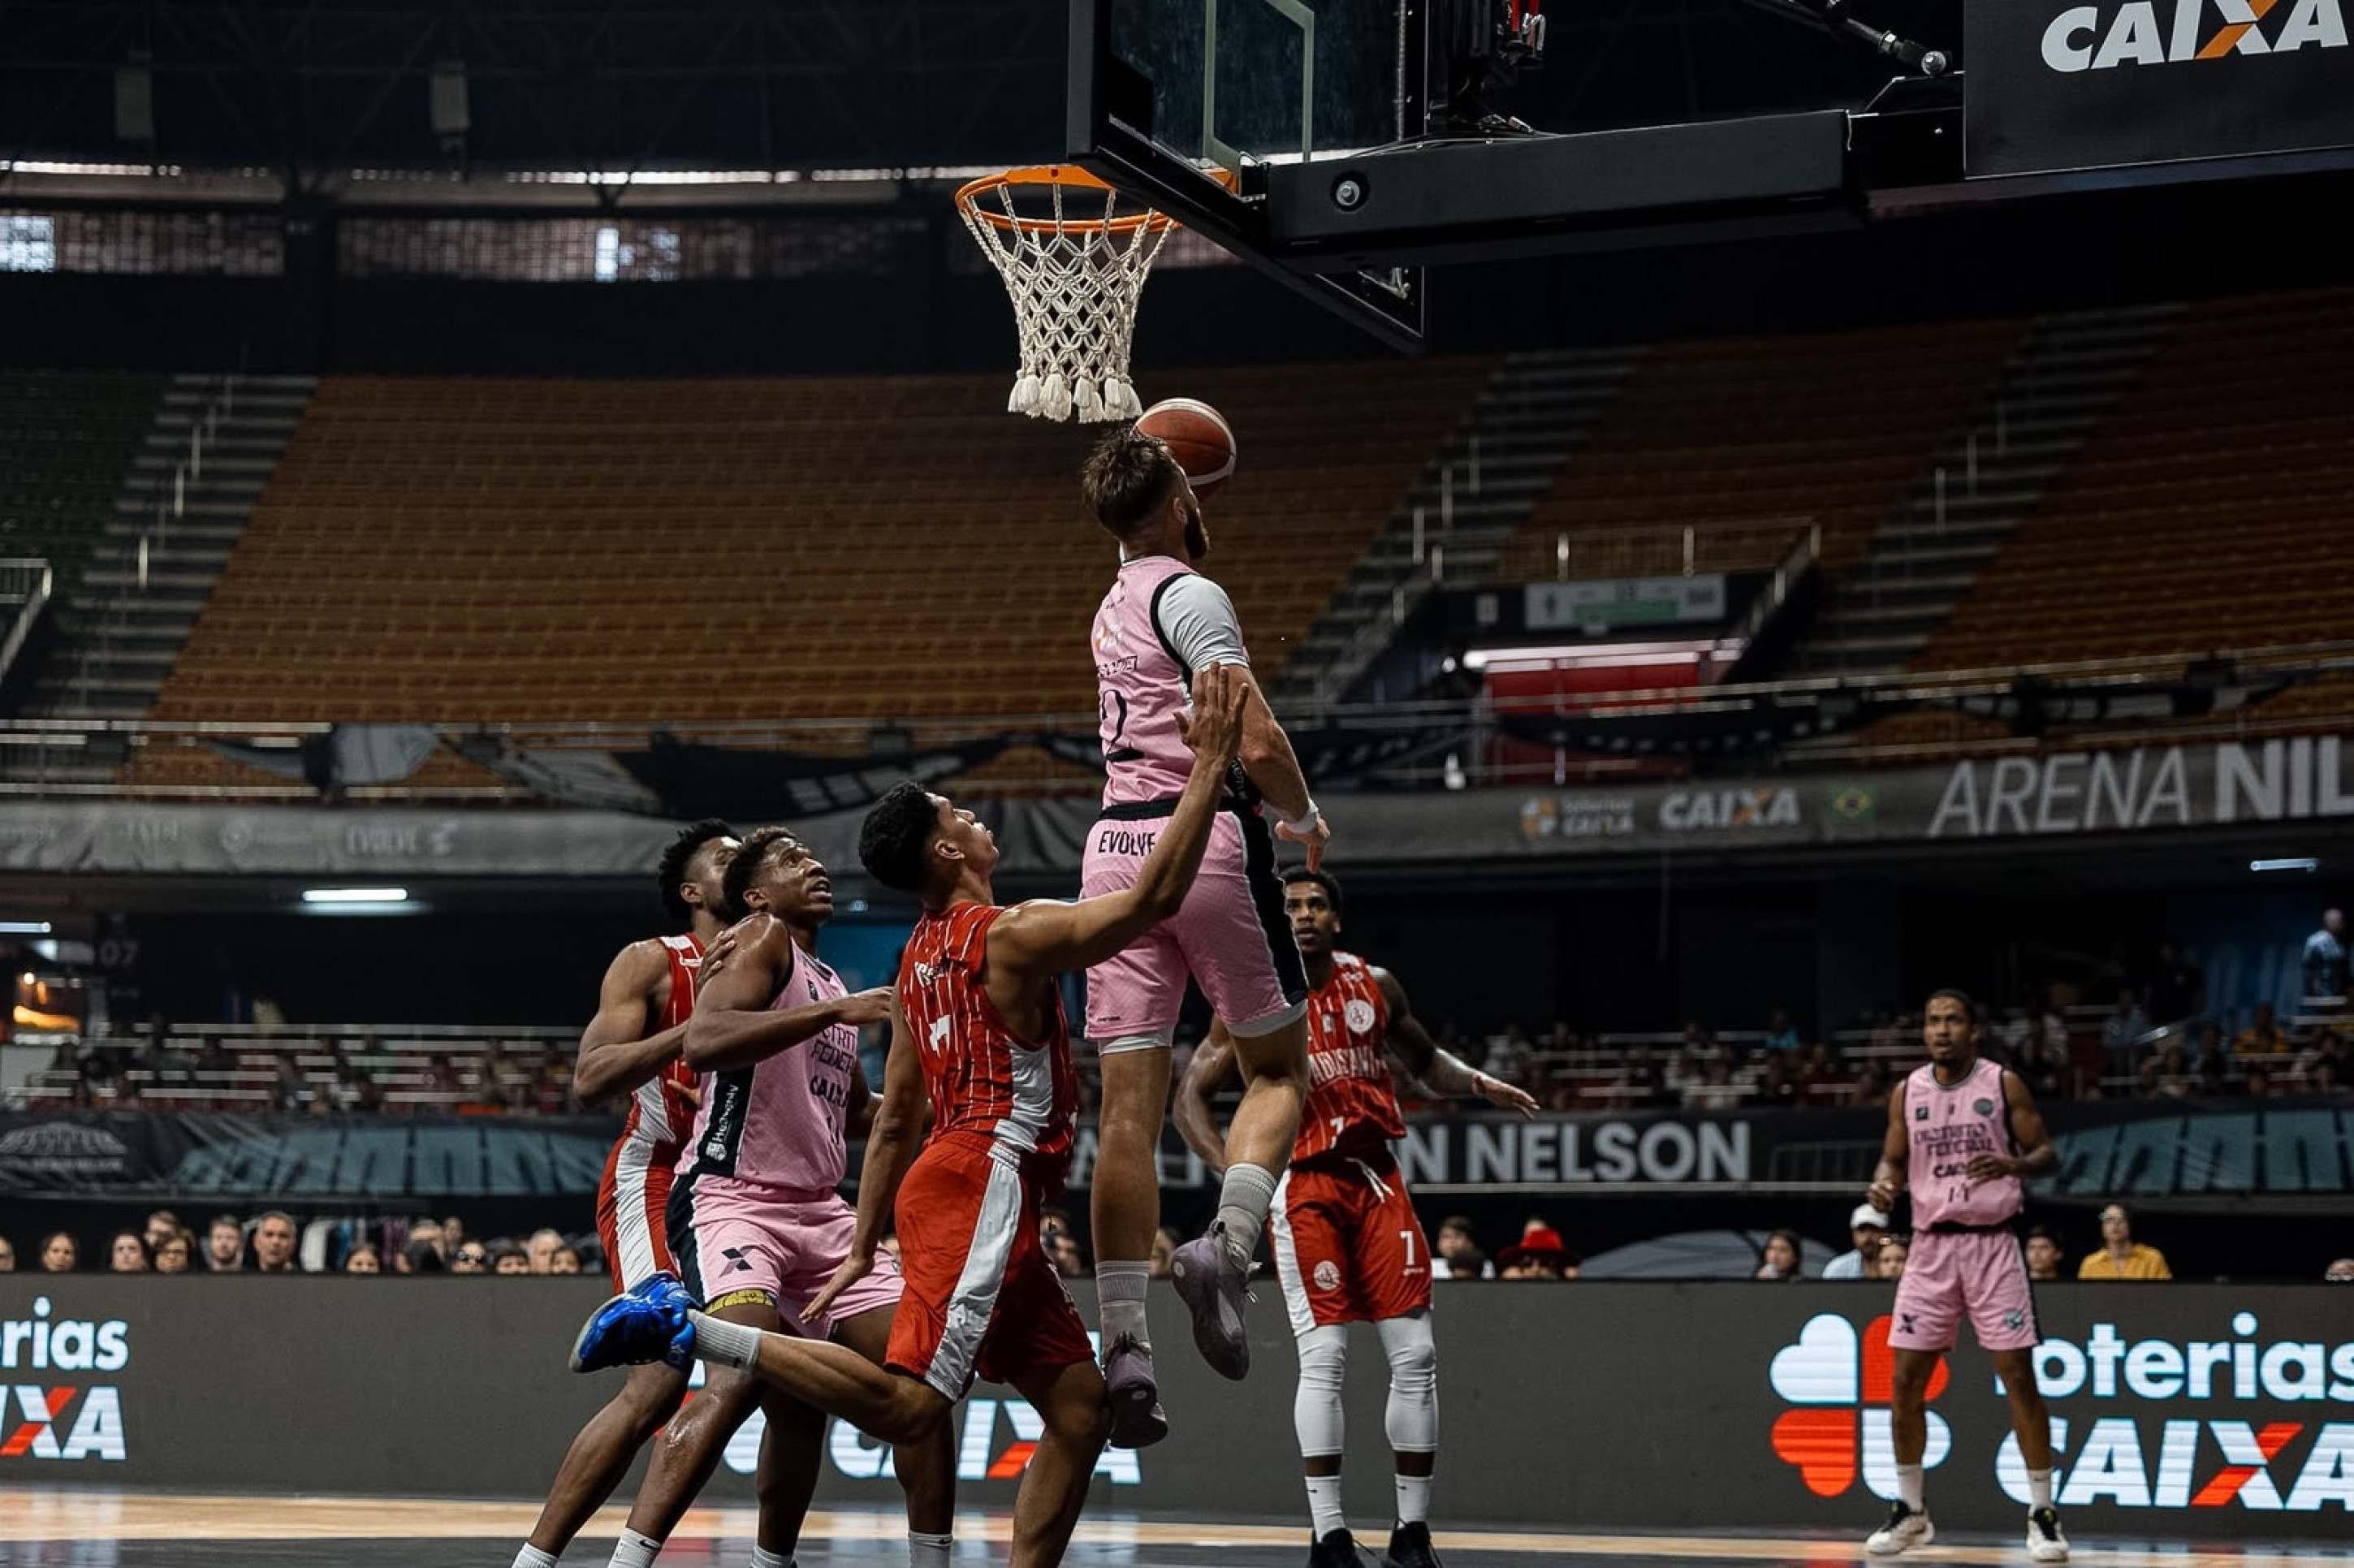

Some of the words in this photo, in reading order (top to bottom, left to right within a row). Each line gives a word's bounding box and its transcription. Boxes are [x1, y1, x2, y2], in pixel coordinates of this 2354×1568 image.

[2041, 0, 2348, 72] CAIXA
[1659, 786, 1801, 828] CAIXA
[1925, 746, 2190, 838] ARENA
[2214, 735, 2354, 823] NIL
[1466, 1121, 1751, 1182] NELSON
[0, 1296, 129, 1372] rias
[1995, 1311, 2354, 1402] oterias
[0, 1384, 127, 1459] XA
